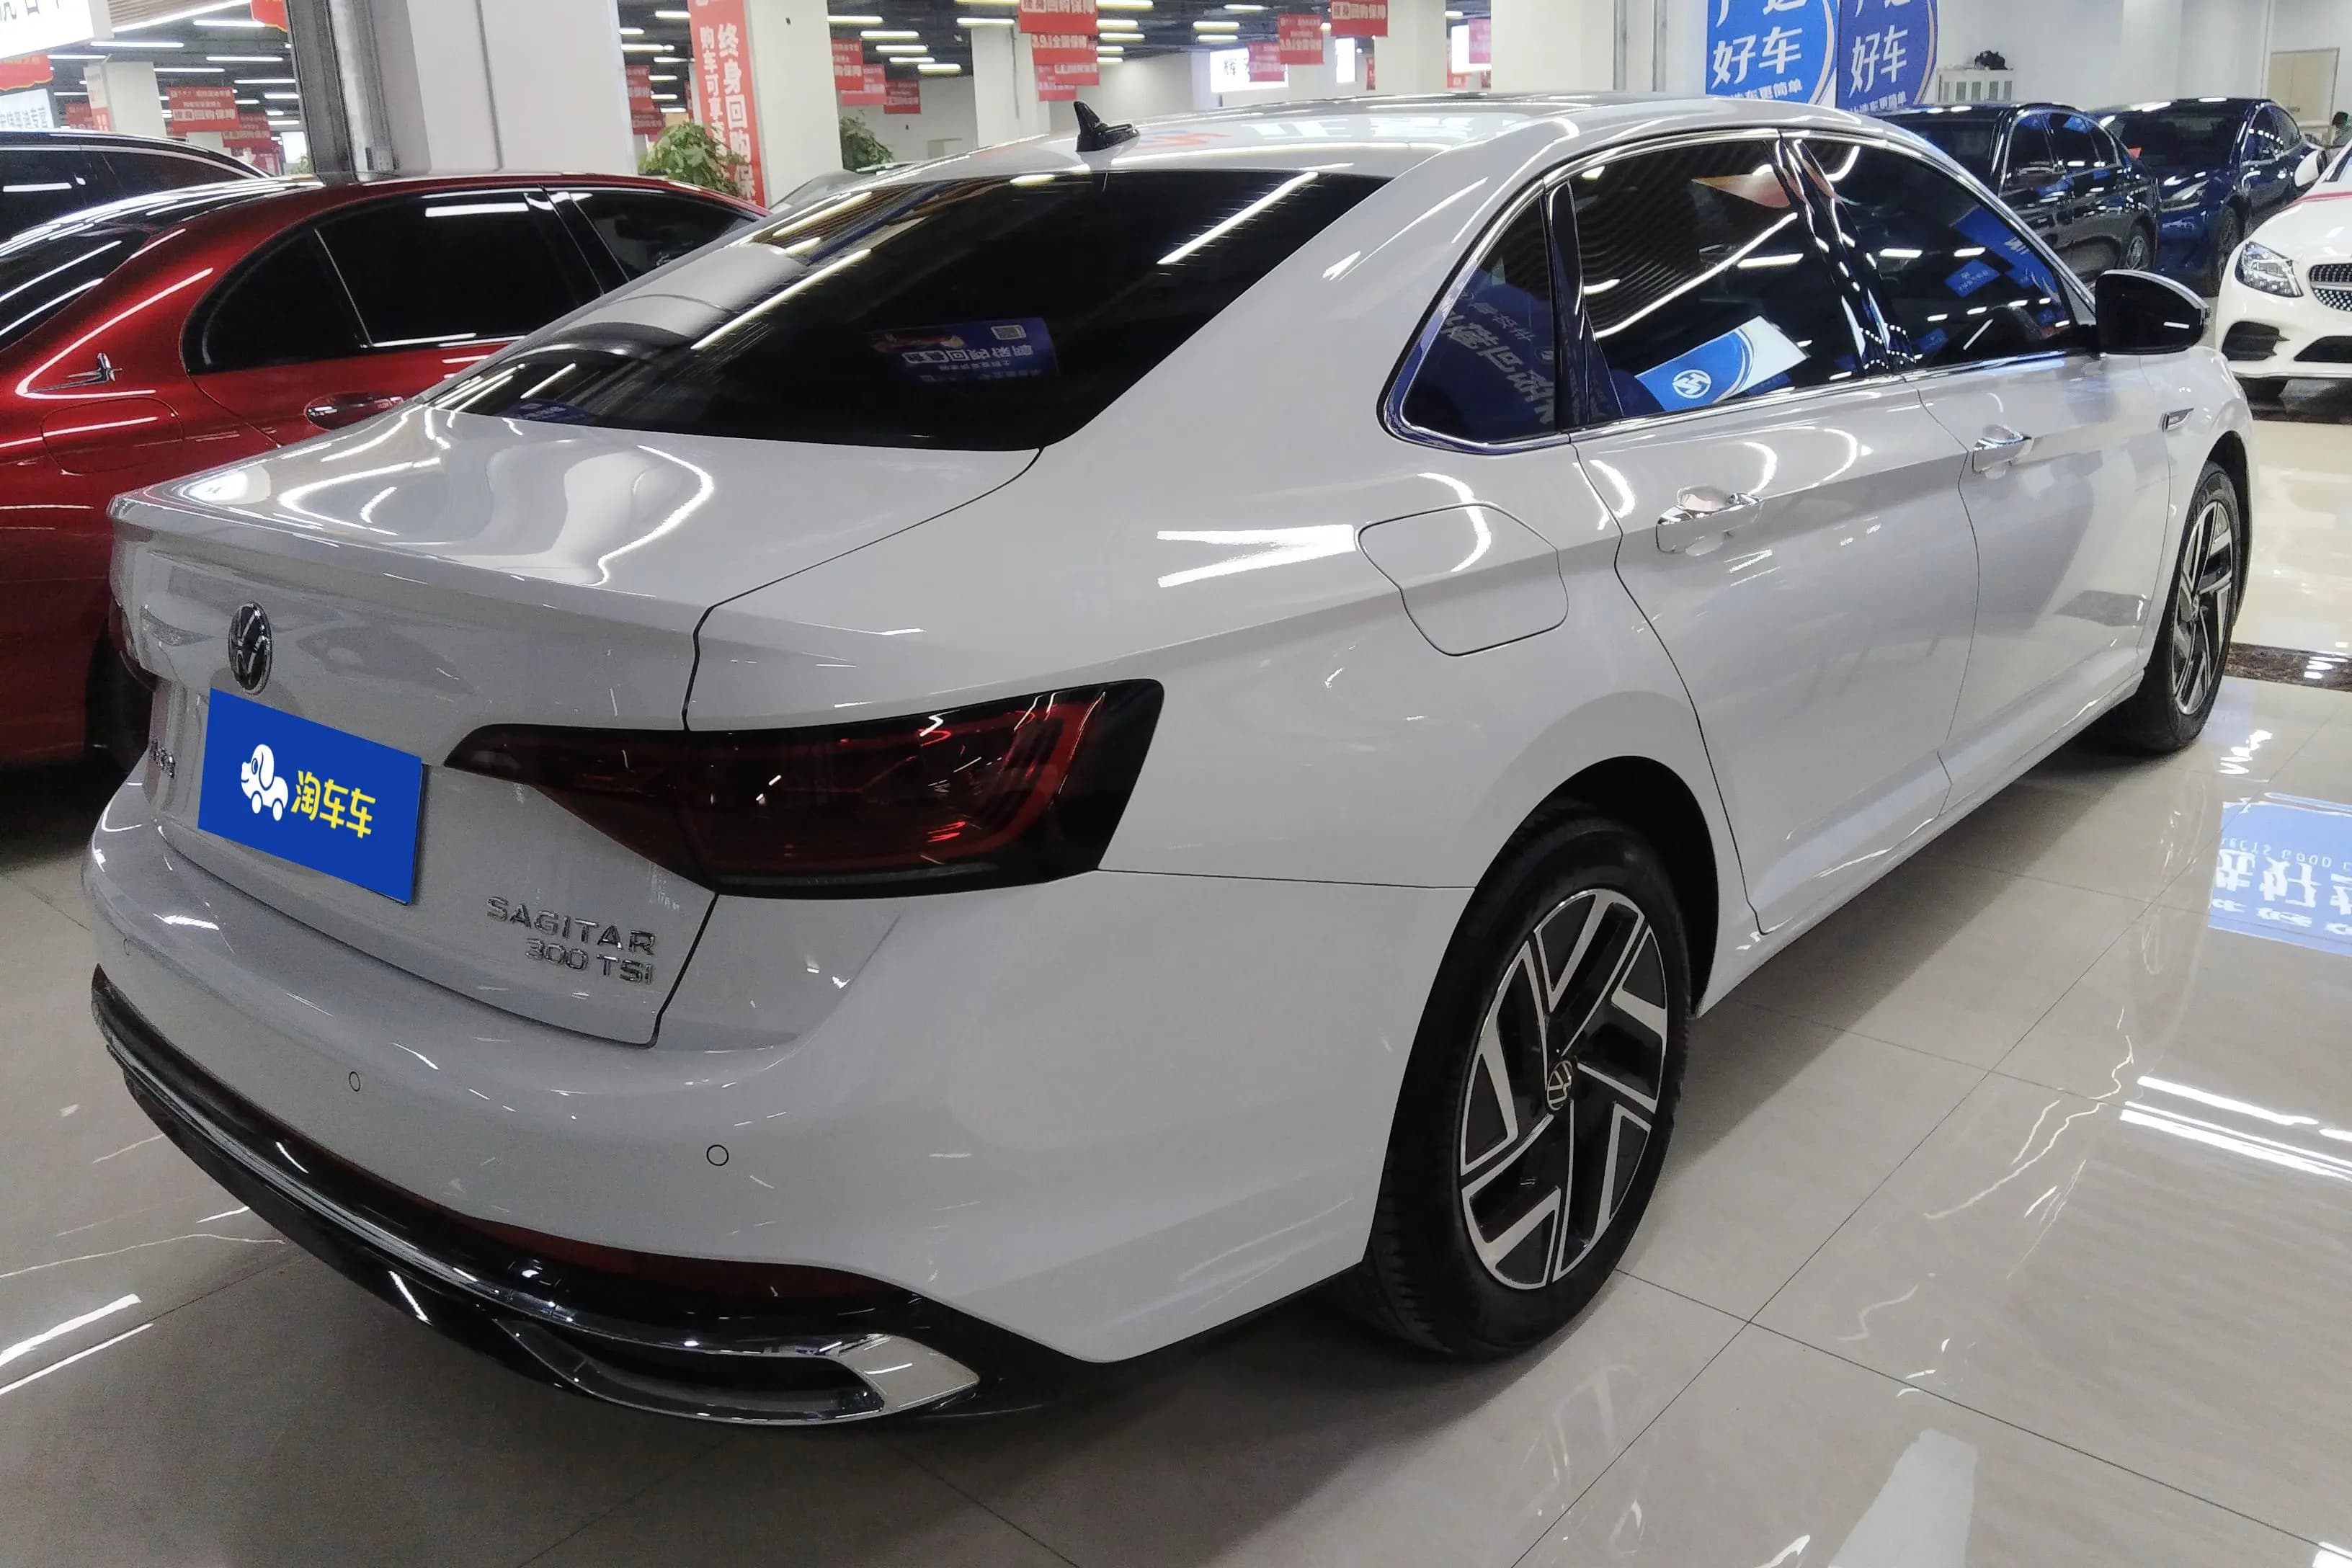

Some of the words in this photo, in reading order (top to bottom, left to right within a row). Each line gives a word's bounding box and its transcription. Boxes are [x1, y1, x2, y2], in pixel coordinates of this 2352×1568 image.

[1711, 25, 1803, 89] 好车
[1848, 24, 1909, 99] 好车
[717, 22, 758, 202] 终身回购保
[487, 896, 656, 956] SAGITAR
[525, 937, 589, 971] 300
[596, 953, 653, 985] TSI
